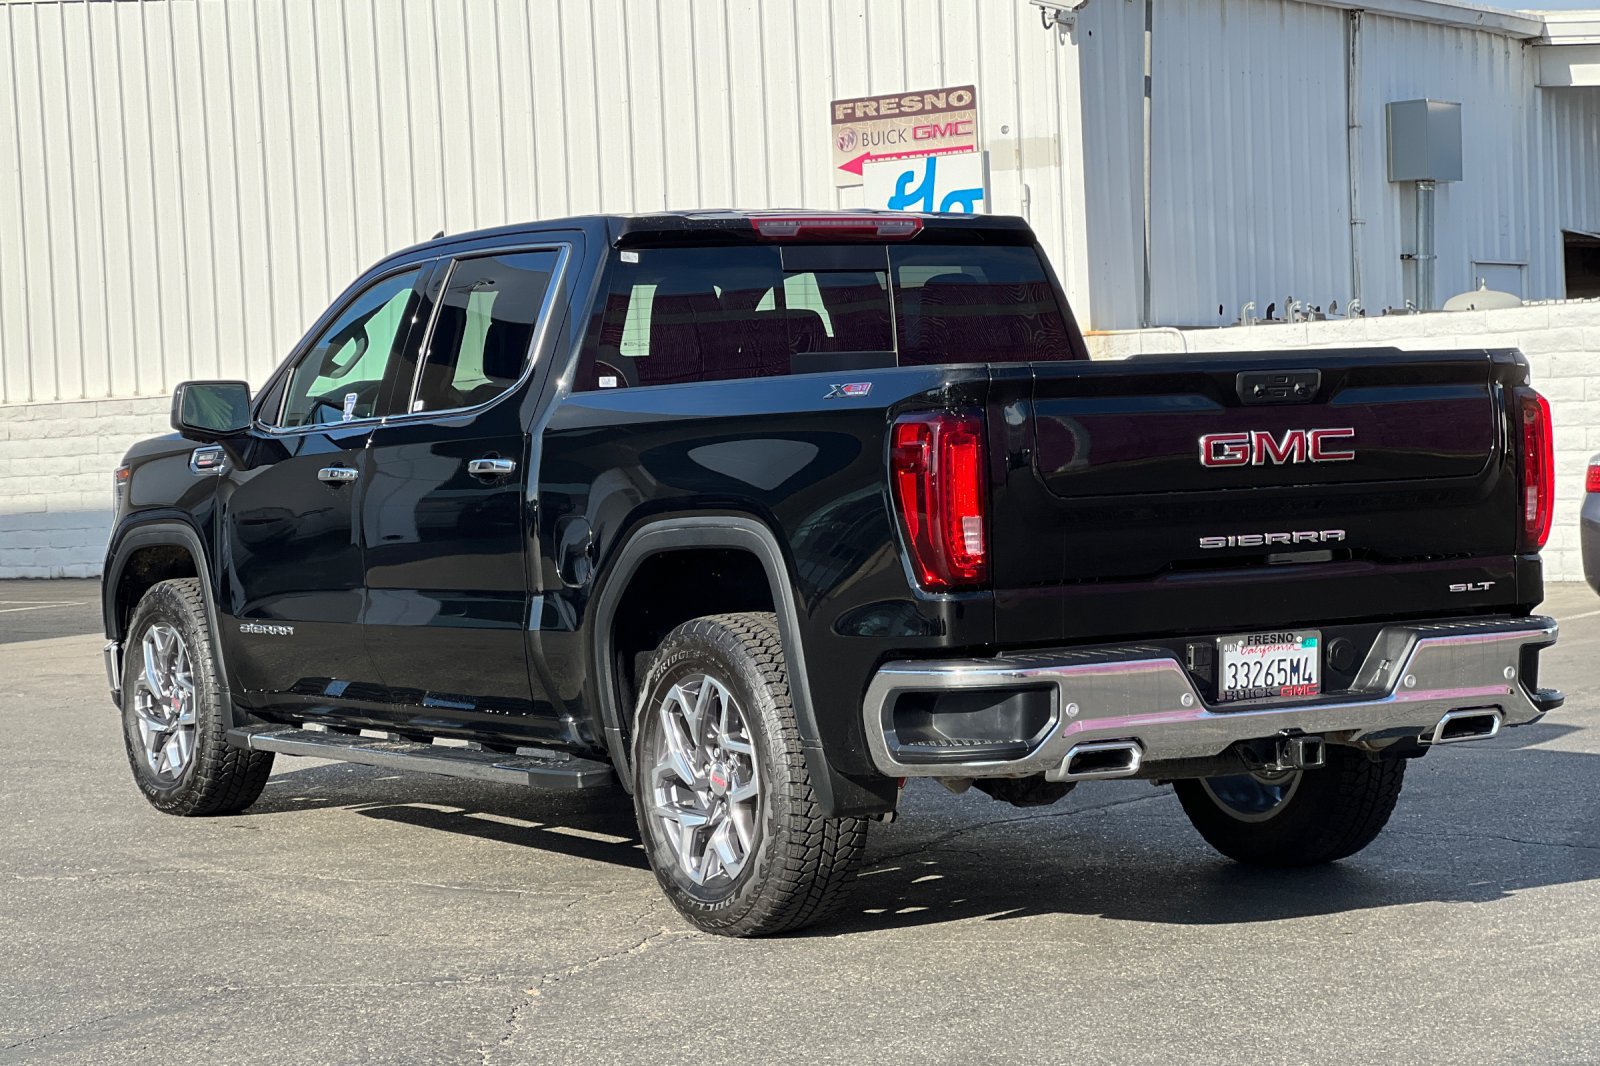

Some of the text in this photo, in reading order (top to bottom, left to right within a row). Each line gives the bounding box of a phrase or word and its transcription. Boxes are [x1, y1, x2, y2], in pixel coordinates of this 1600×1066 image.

[835, 90, 973, 120] FRESNO
[861, 120, 973, 147] BUICK GMC
[1198, 427, 1355, 468] GMC
[1199, 529, 1346, 549] SIERRA
[1449, 581, 1496, 592] SLT
[239, 623, 295, 636] SIERRA
[1247, 632, 1294, 646] FRESNO
[1240, 643, 1302, 658] California
[1227, 656, 1313, 691] 33265M4
[1223, 683, 1319, 701] BUICK GMC
